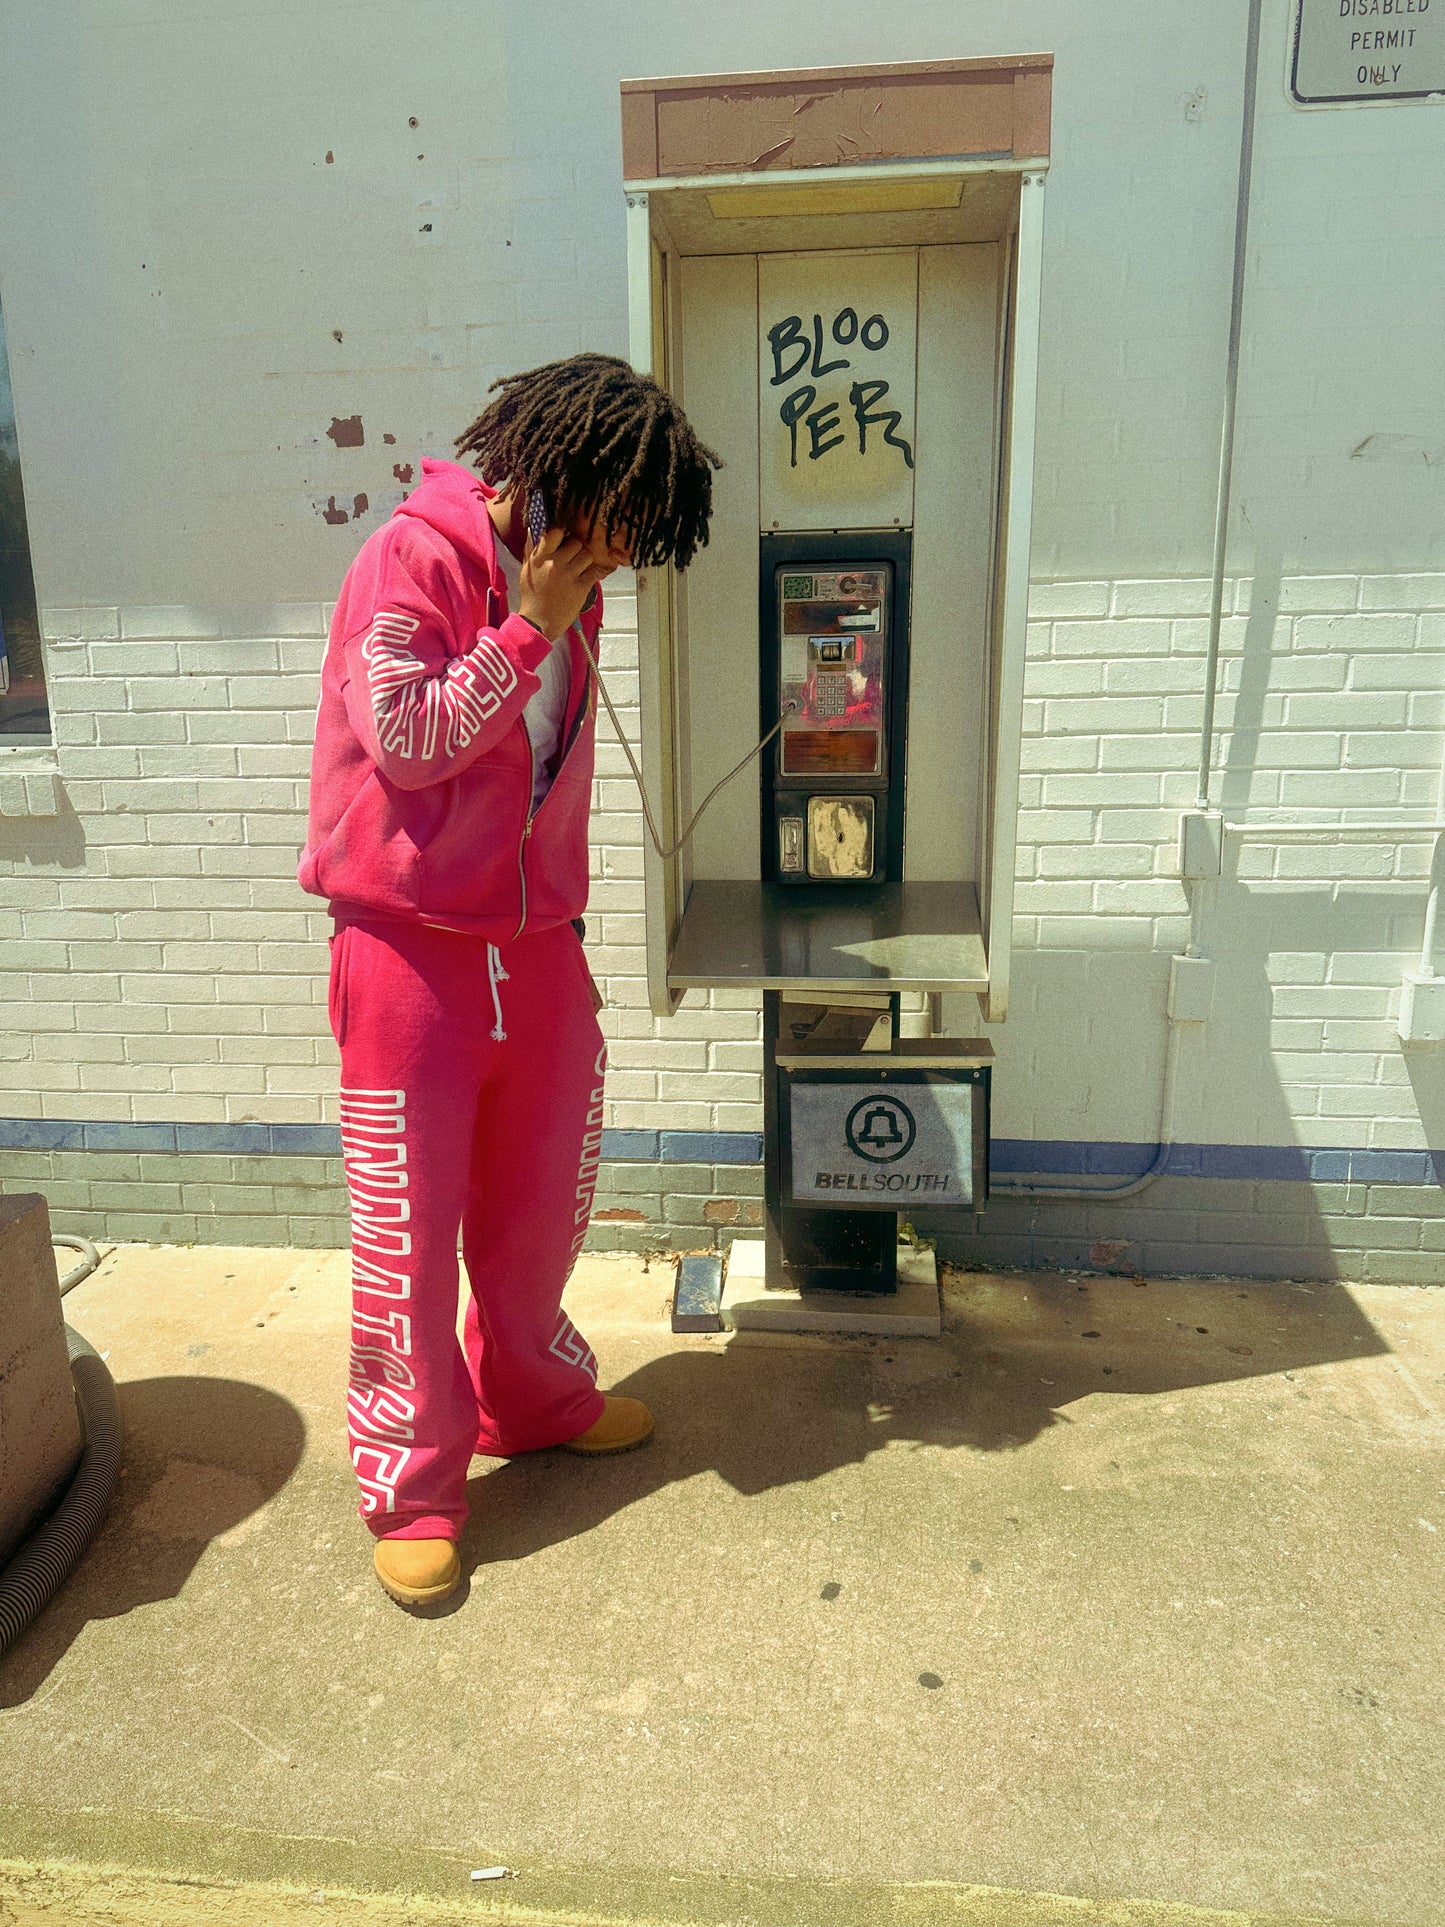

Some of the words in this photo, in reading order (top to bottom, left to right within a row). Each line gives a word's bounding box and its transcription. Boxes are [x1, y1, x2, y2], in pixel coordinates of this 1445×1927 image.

[1340, 0, 1430, 17] DISABLED
[1351, 29, 1417, 50] PERMIT
[1357, 64, 1402, 84] ONLY
[767, 306, 890, 386] BLOO
[780, 379, 914, 469] PER
[814, 1172, 950, 1192] BELLSOUTH
